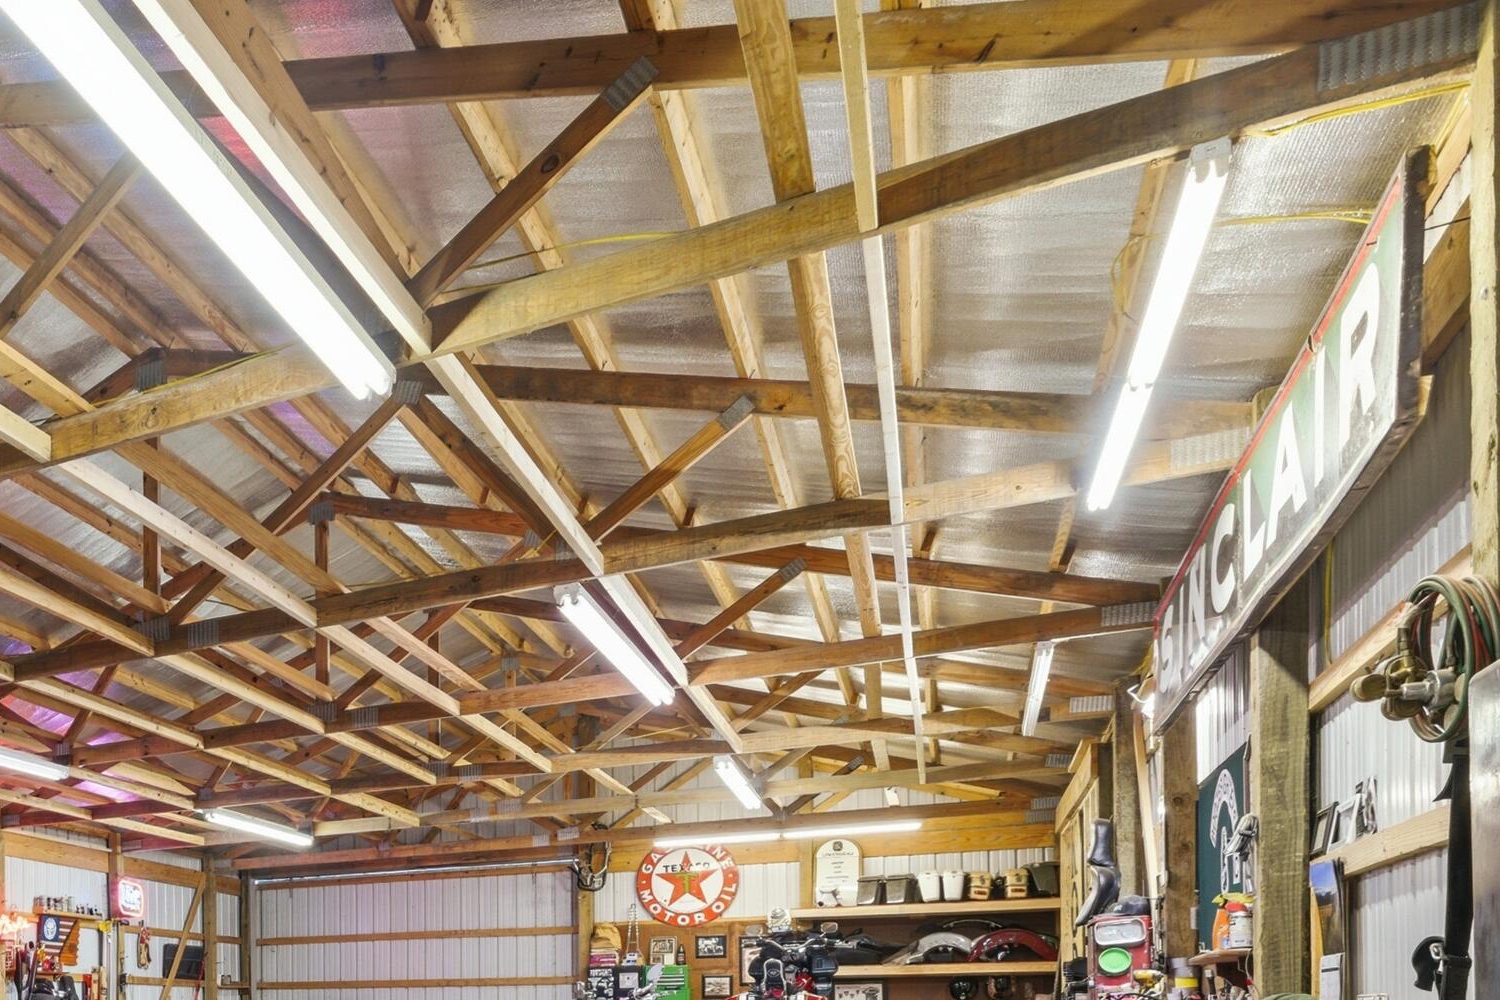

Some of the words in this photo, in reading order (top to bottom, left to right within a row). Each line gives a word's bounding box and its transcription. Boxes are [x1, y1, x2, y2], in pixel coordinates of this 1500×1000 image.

[1159, 262, 1381, 696] SINCLAIR
[639, 888, 707, 926] MOTOR
[711, 882, 738, 915] OIL
